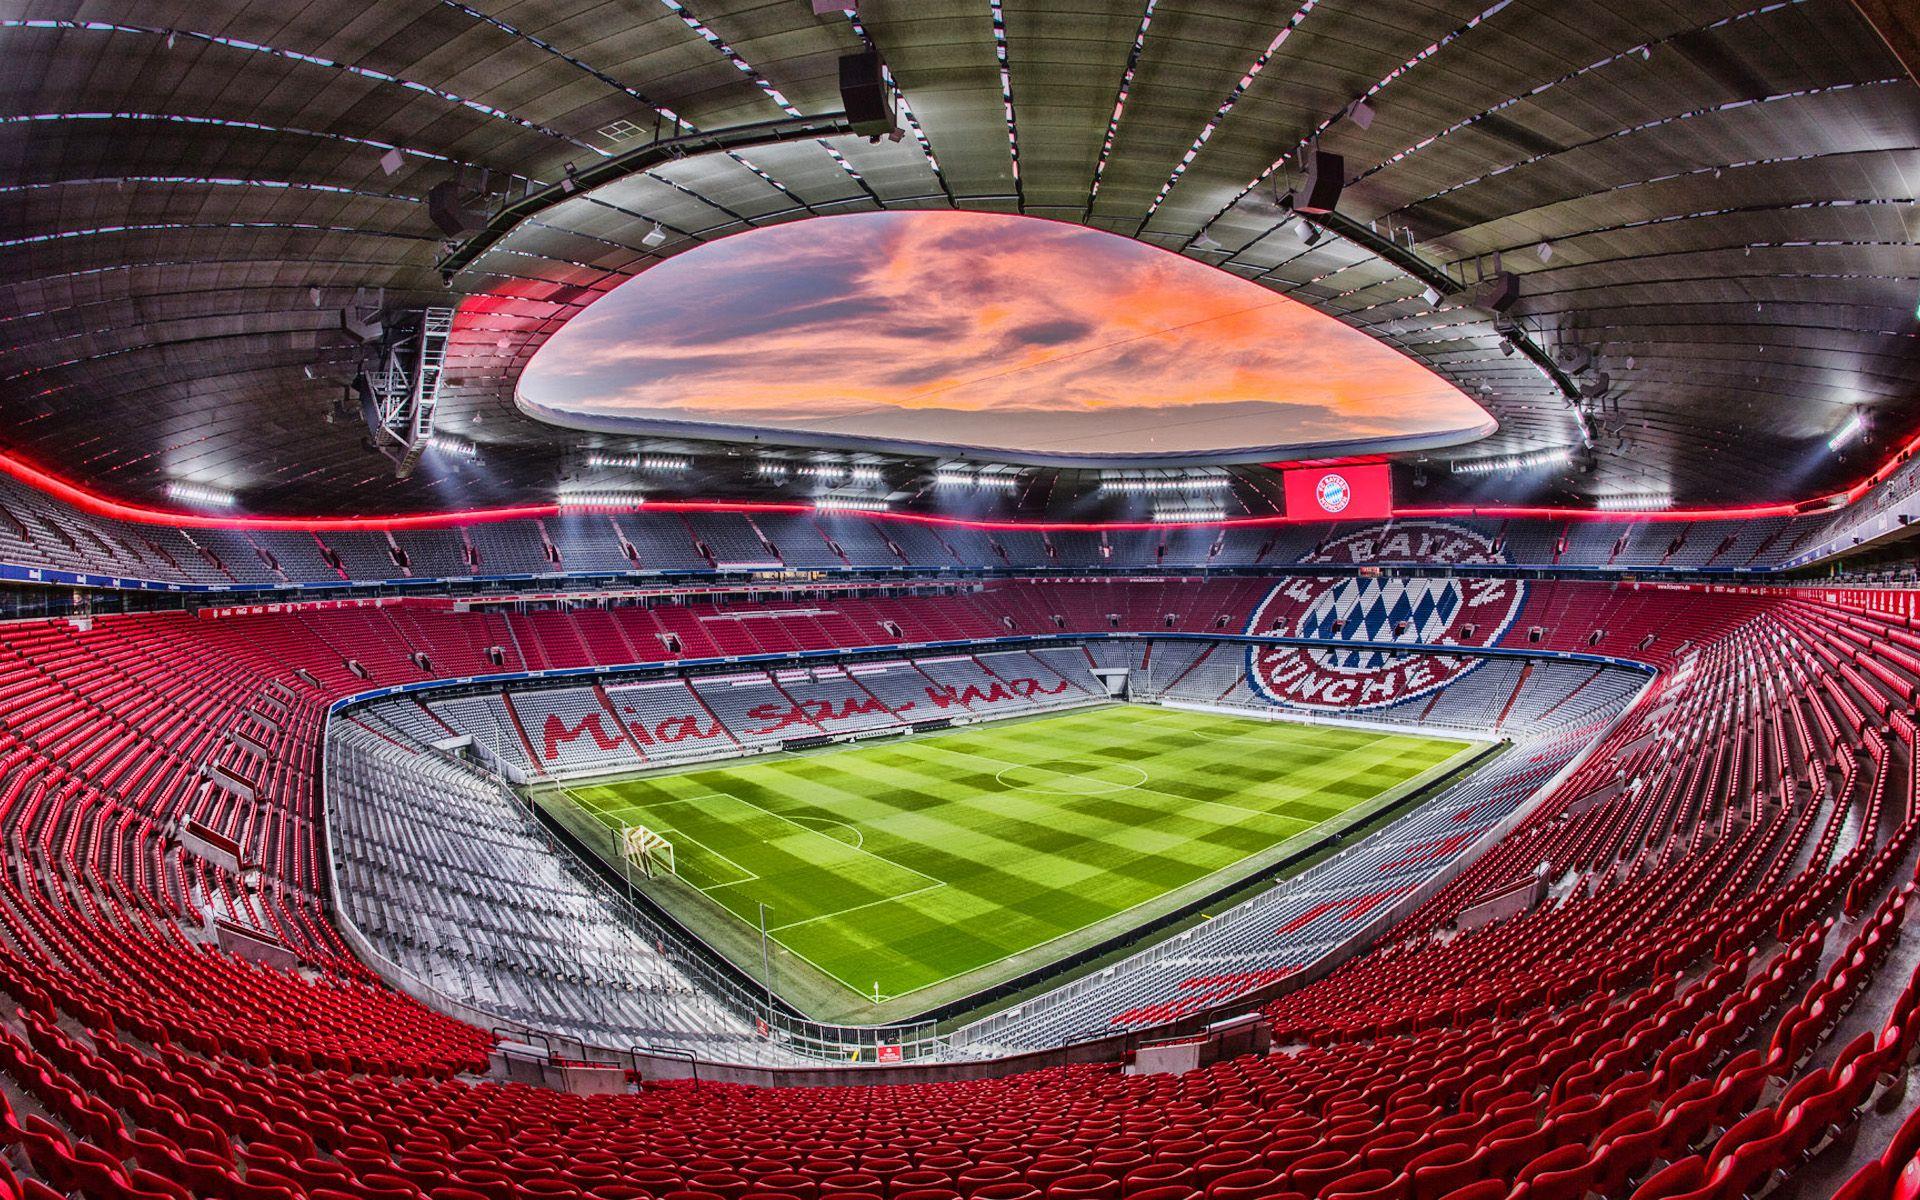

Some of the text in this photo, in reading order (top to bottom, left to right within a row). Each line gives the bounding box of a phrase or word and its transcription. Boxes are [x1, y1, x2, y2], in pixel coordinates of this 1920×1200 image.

[1324, 476, 1347, 491] BAYERN
[544, 706, 722, 760] Mia
[744, 698, 915, 735] san
